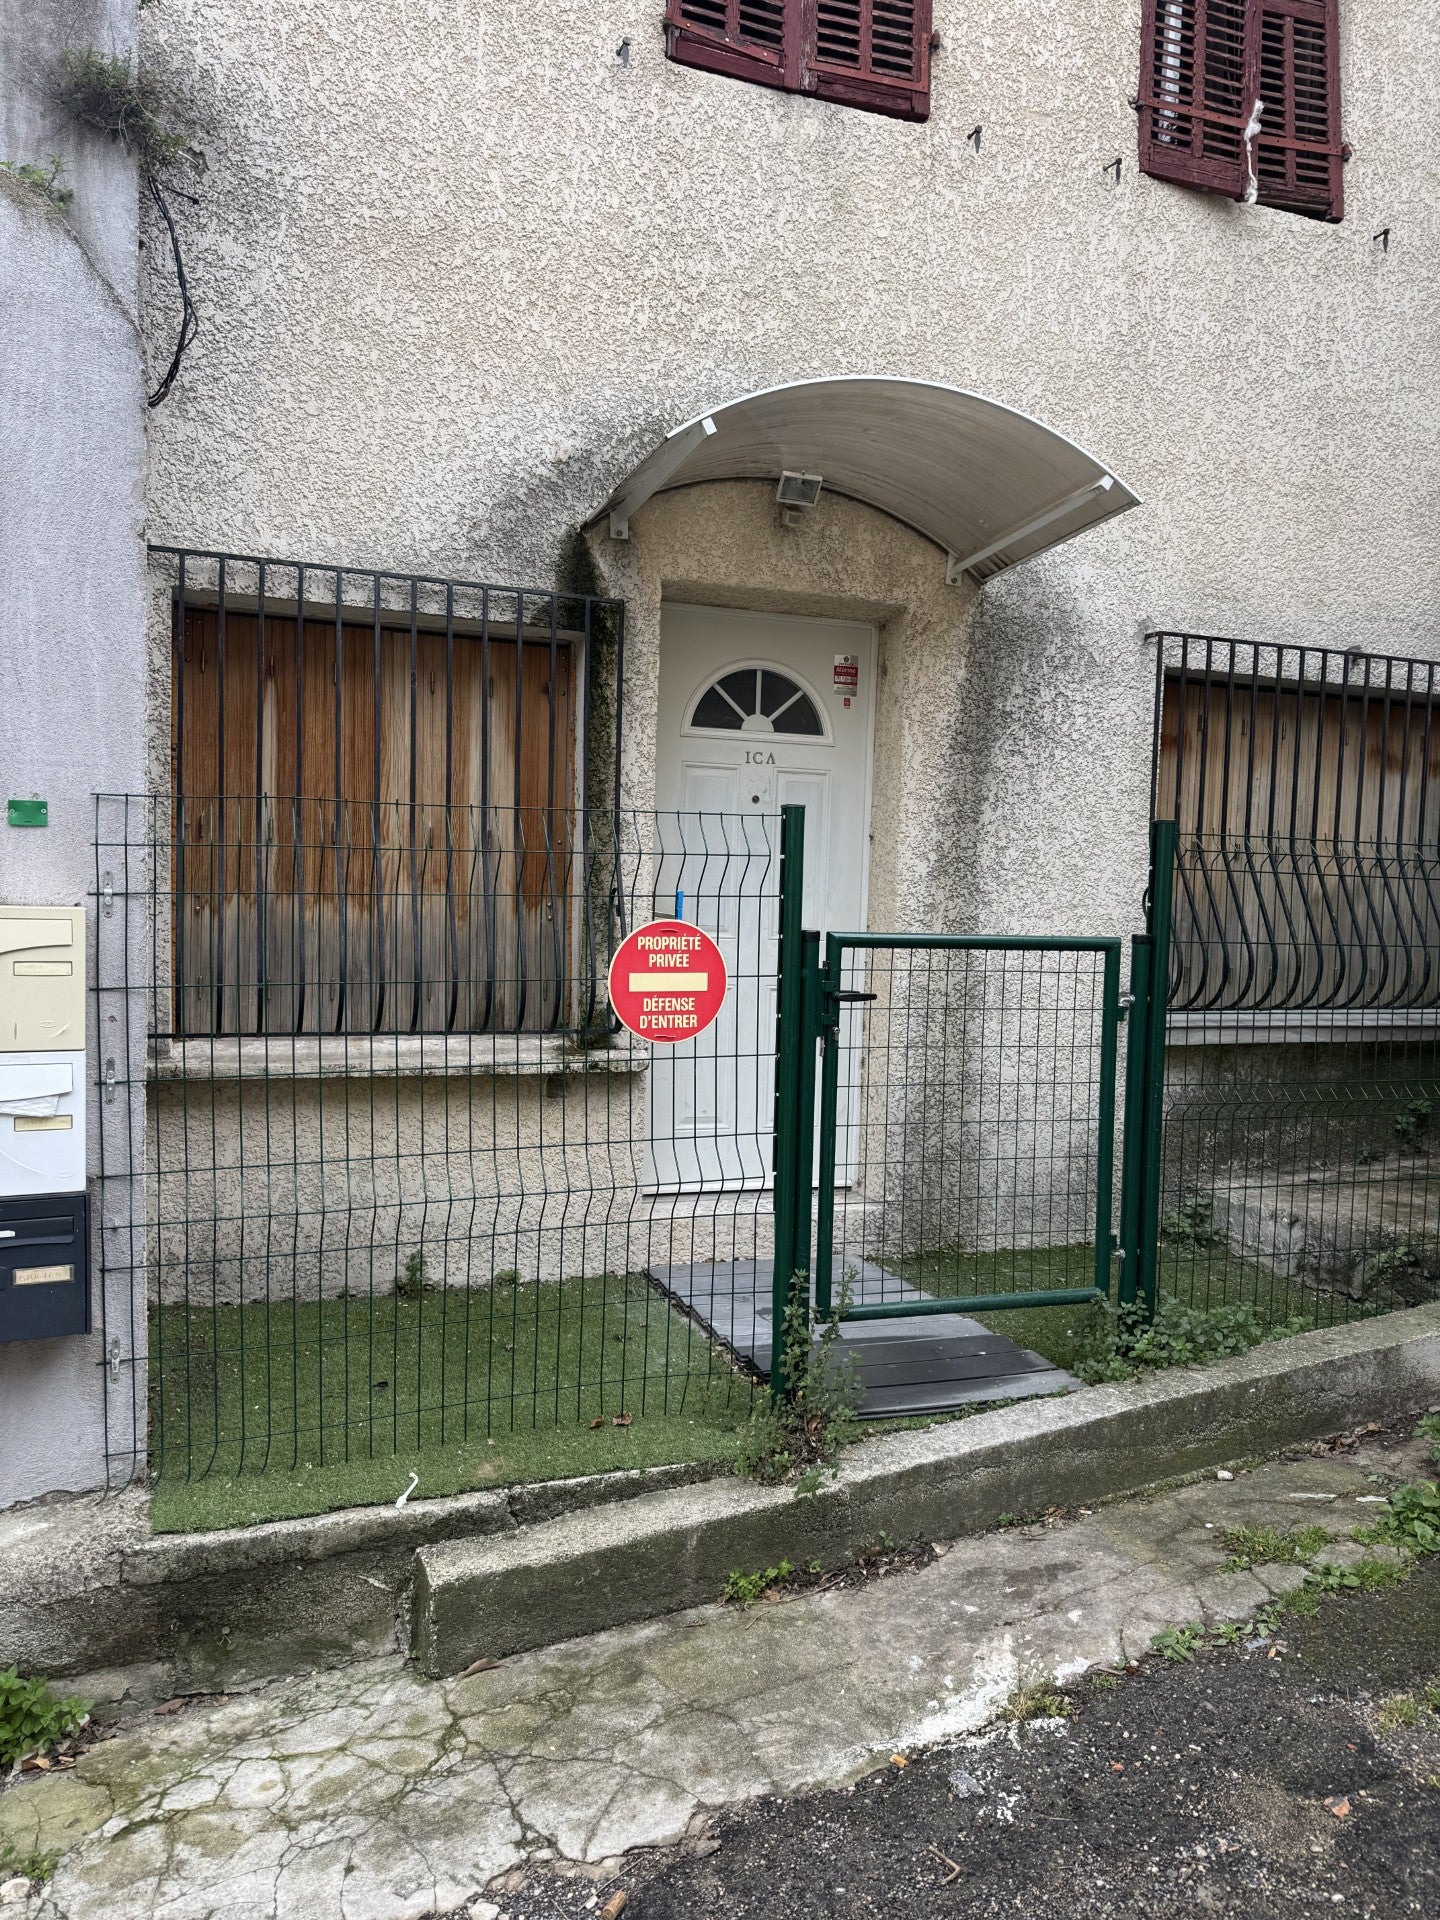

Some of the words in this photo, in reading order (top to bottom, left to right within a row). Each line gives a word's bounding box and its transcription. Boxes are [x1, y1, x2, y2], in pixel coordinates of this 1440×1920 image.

[637, 933, 702, 951] PROPRIÉTÉ
[648, 950, 690, 968] PRIVÉE
[643, 994, 695, 1012] DÉFENSE
[639, 1014, 698, 1029] D'ENTRER
